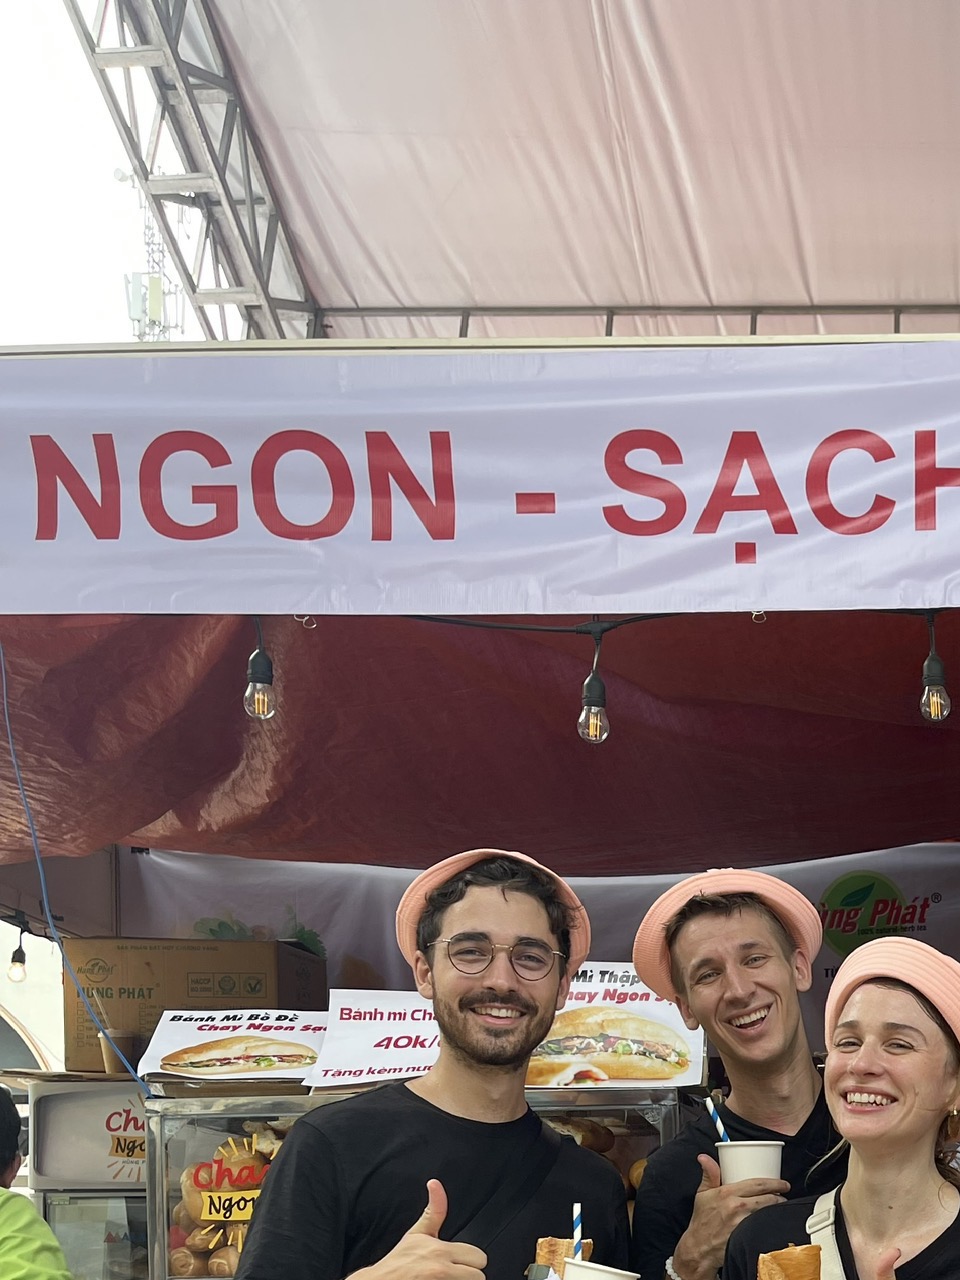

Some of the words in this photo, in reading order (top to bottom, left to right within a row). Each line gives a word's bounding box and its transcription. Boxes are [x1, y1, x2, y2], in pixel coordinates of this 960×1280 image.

[30, 429, 456, 541] NGON
[821, 902, 863, 933] ùng
[869, 896, 931, 926] Phát
[118, 984, 154, 999] PHÁT
[602, 989, 651, 1003] Ngon
[169, 1014, 216, 1022] Bánh
[220, 1013, 243, 1022] Mì
[340, 1008, 384, 1021] Bánh
[388, 1009, 407, 1021] mì
[197, 1023, 243, 1031] Chay
[246, 1023, 295, 1031] Ngon
[366, 1066, 403, 1075] kèm
